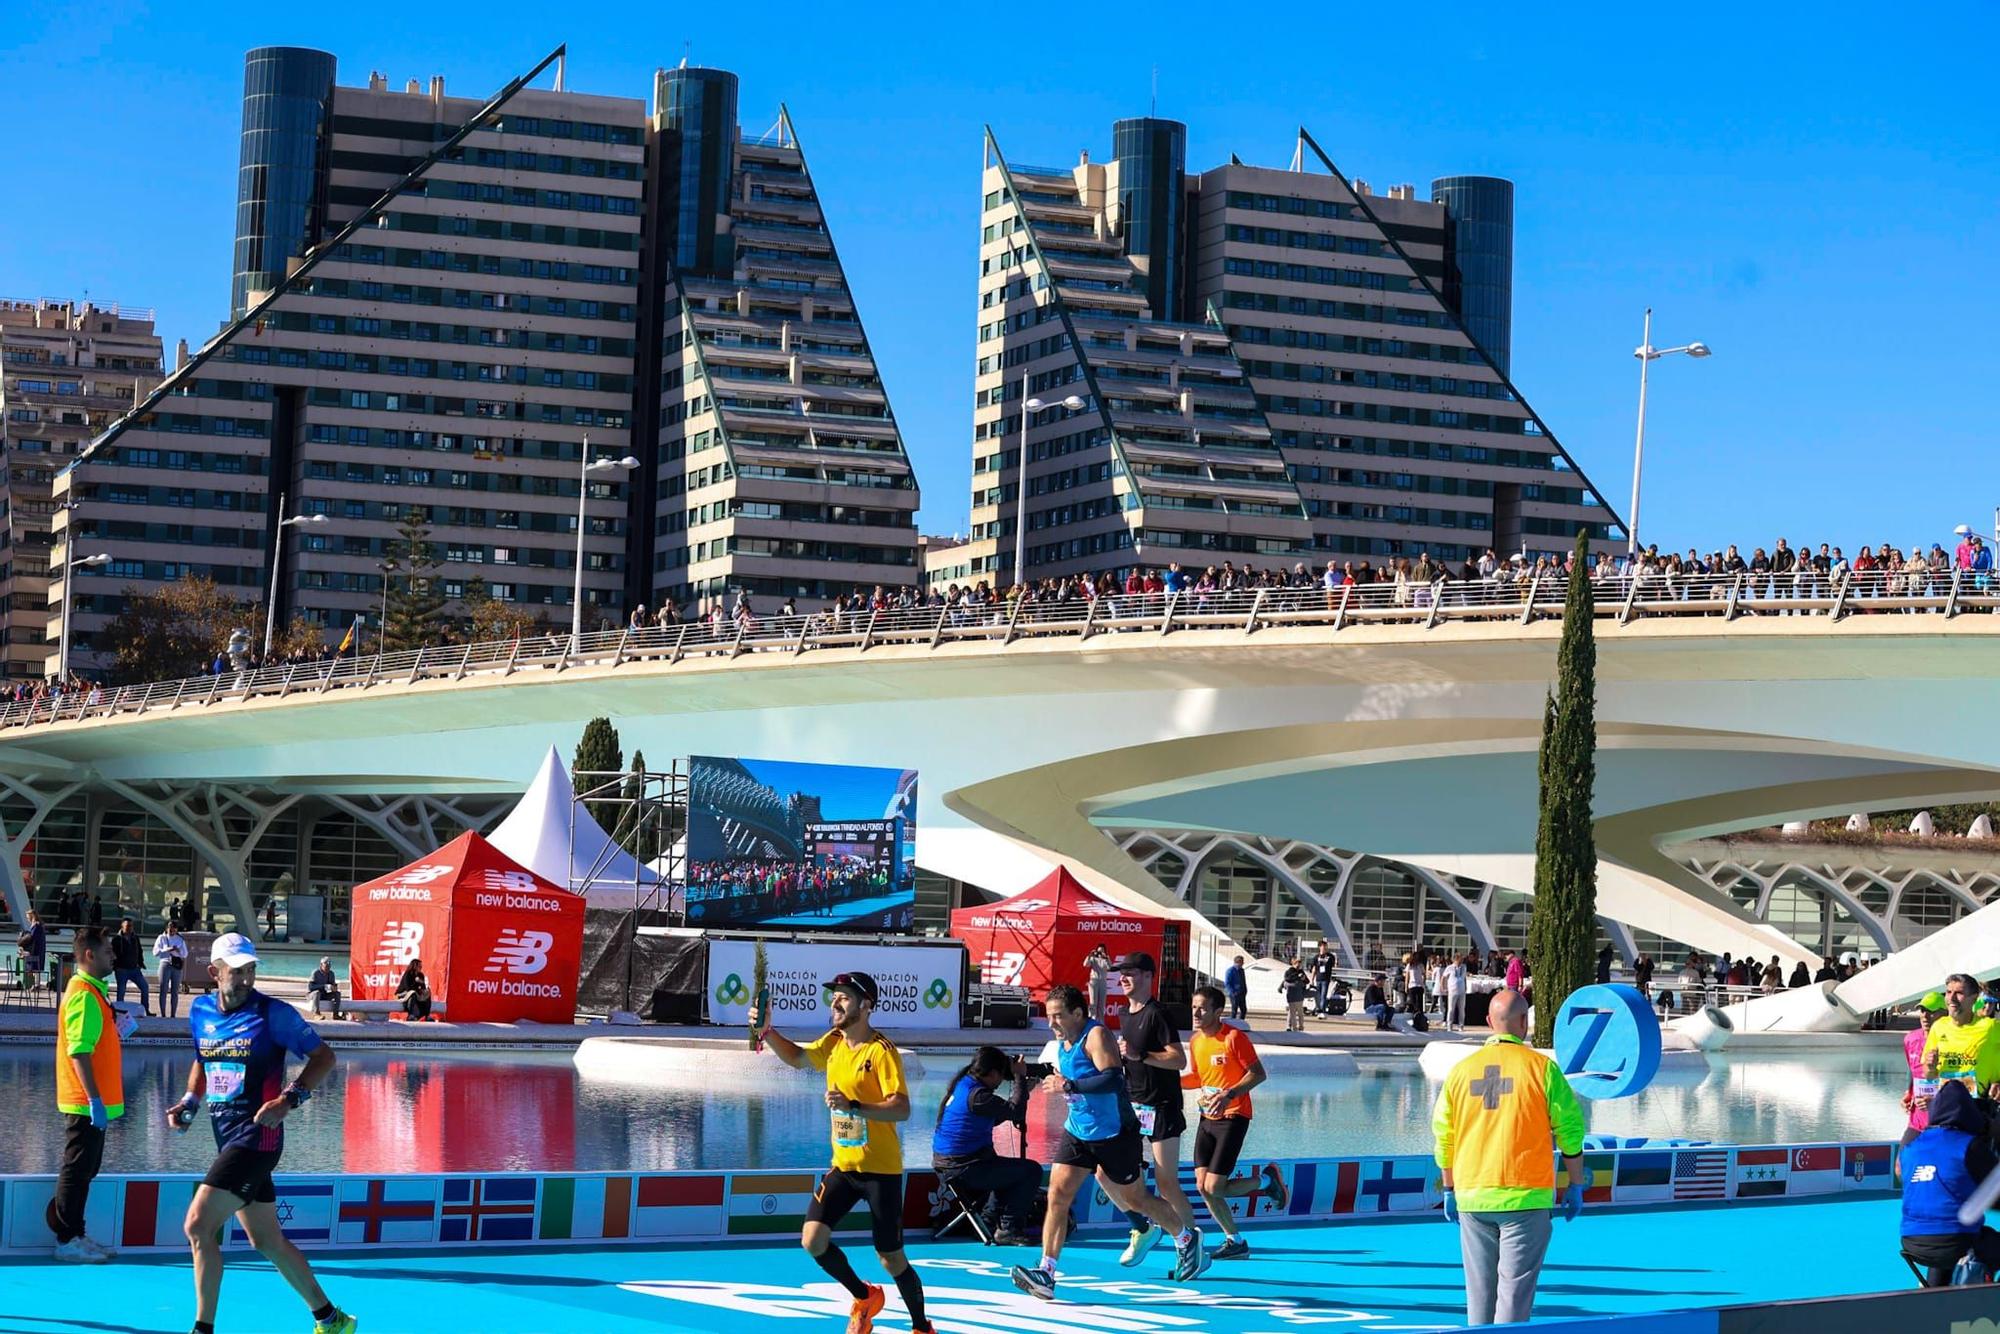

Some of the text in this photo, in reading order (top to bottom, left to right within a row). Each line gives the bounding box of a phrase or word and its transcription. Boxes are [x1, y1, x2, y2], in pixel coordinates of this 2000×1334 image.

[369, 888, 389, 900] new
[476, 893, 562, 911] new balance.
[971, 916, 991, 927] new
[1077, 920, 1099, 931] new
[770, 970, 817, 979] NDACIÓN
[874, 972, 918, 982] NDACIÓN
[468, 978, 562, 998] new balance.
[766, 983, 817, 996] INIDAD
[880, 986, 918, 998] NIDAD
[772, 998, 817, 1010] FONSO
[875, 1000, 918, 1012] FONSO
[200, 1038, 251, 1047] TRIATHLON
